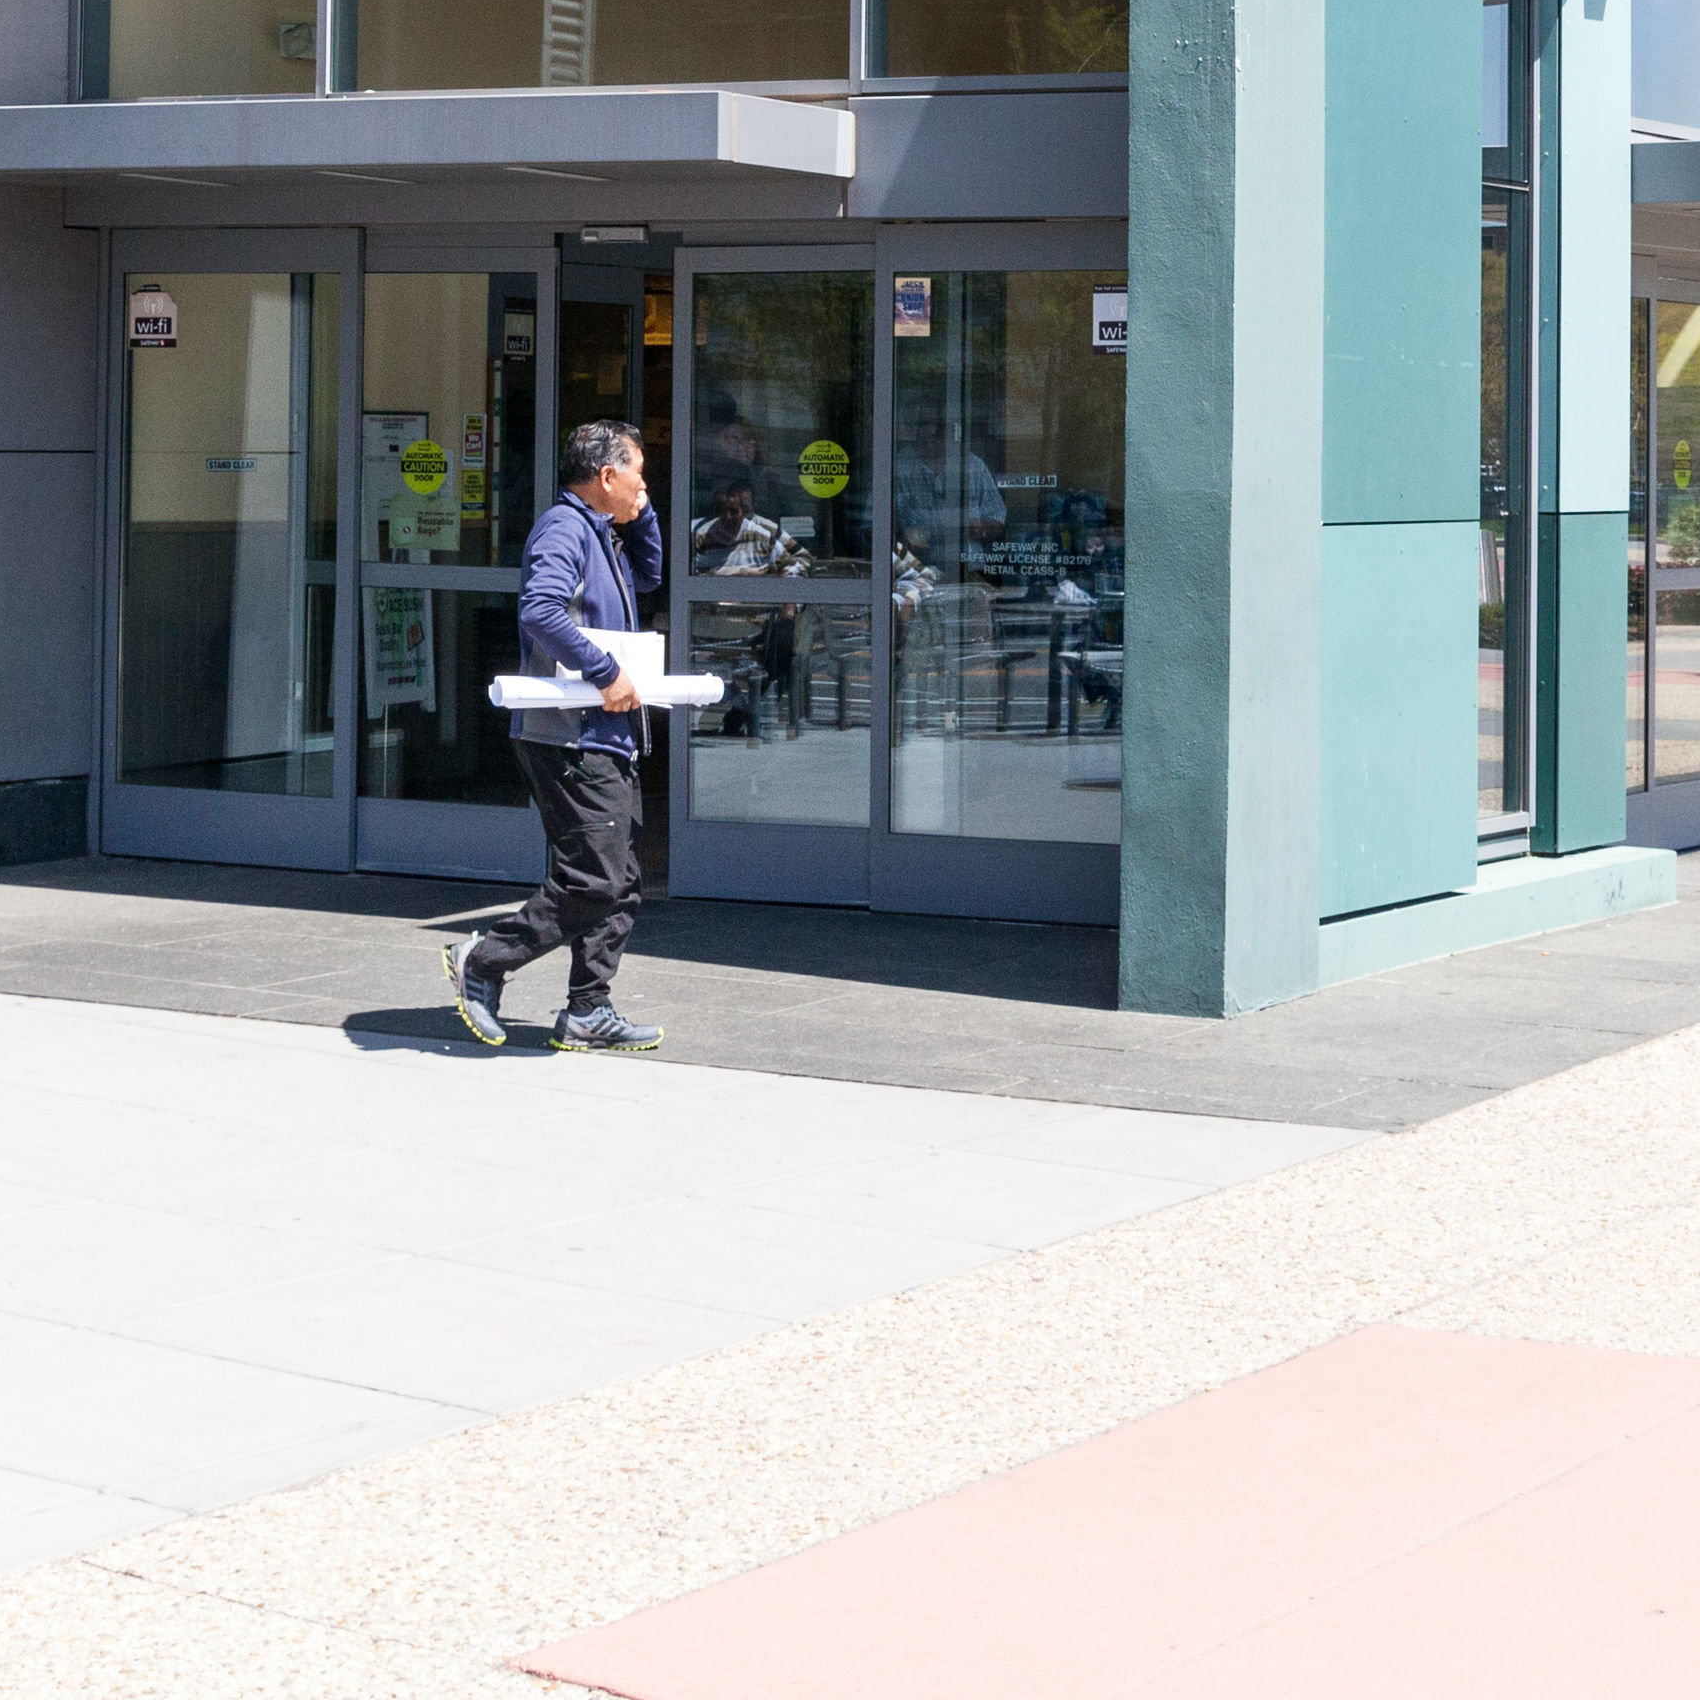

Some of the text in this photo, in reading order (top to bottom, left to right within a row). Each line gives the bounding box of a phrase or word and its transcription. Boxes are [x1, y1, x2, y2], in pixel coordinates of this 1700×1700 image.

[136, 318, 168, 333] wi-fi
[1101, 322, 1128, 340] wi-
[405, 452, 444, 460] AUTOMATIC
[803, 453, 846, 461] AUTOMATIC
[208, 461, 256, 469] STAND CLEAR
[403, 462, 445, 472] CAUTION
[801, 464, 847, 475] CAUTION
[414, 474, 434, 482] DOOR
[812, 477, 835, 485] DOOR
[1028, 475, 1056, 486] CLEAR
[992, 541, 1058, 553] SAFEWAY INC
[960, 553, 1005, 563] SAFEWAY
[1008, 554, 1051, 565] LICENSE
[983, 565, 1067, 577] RETAIL CLASS-B
